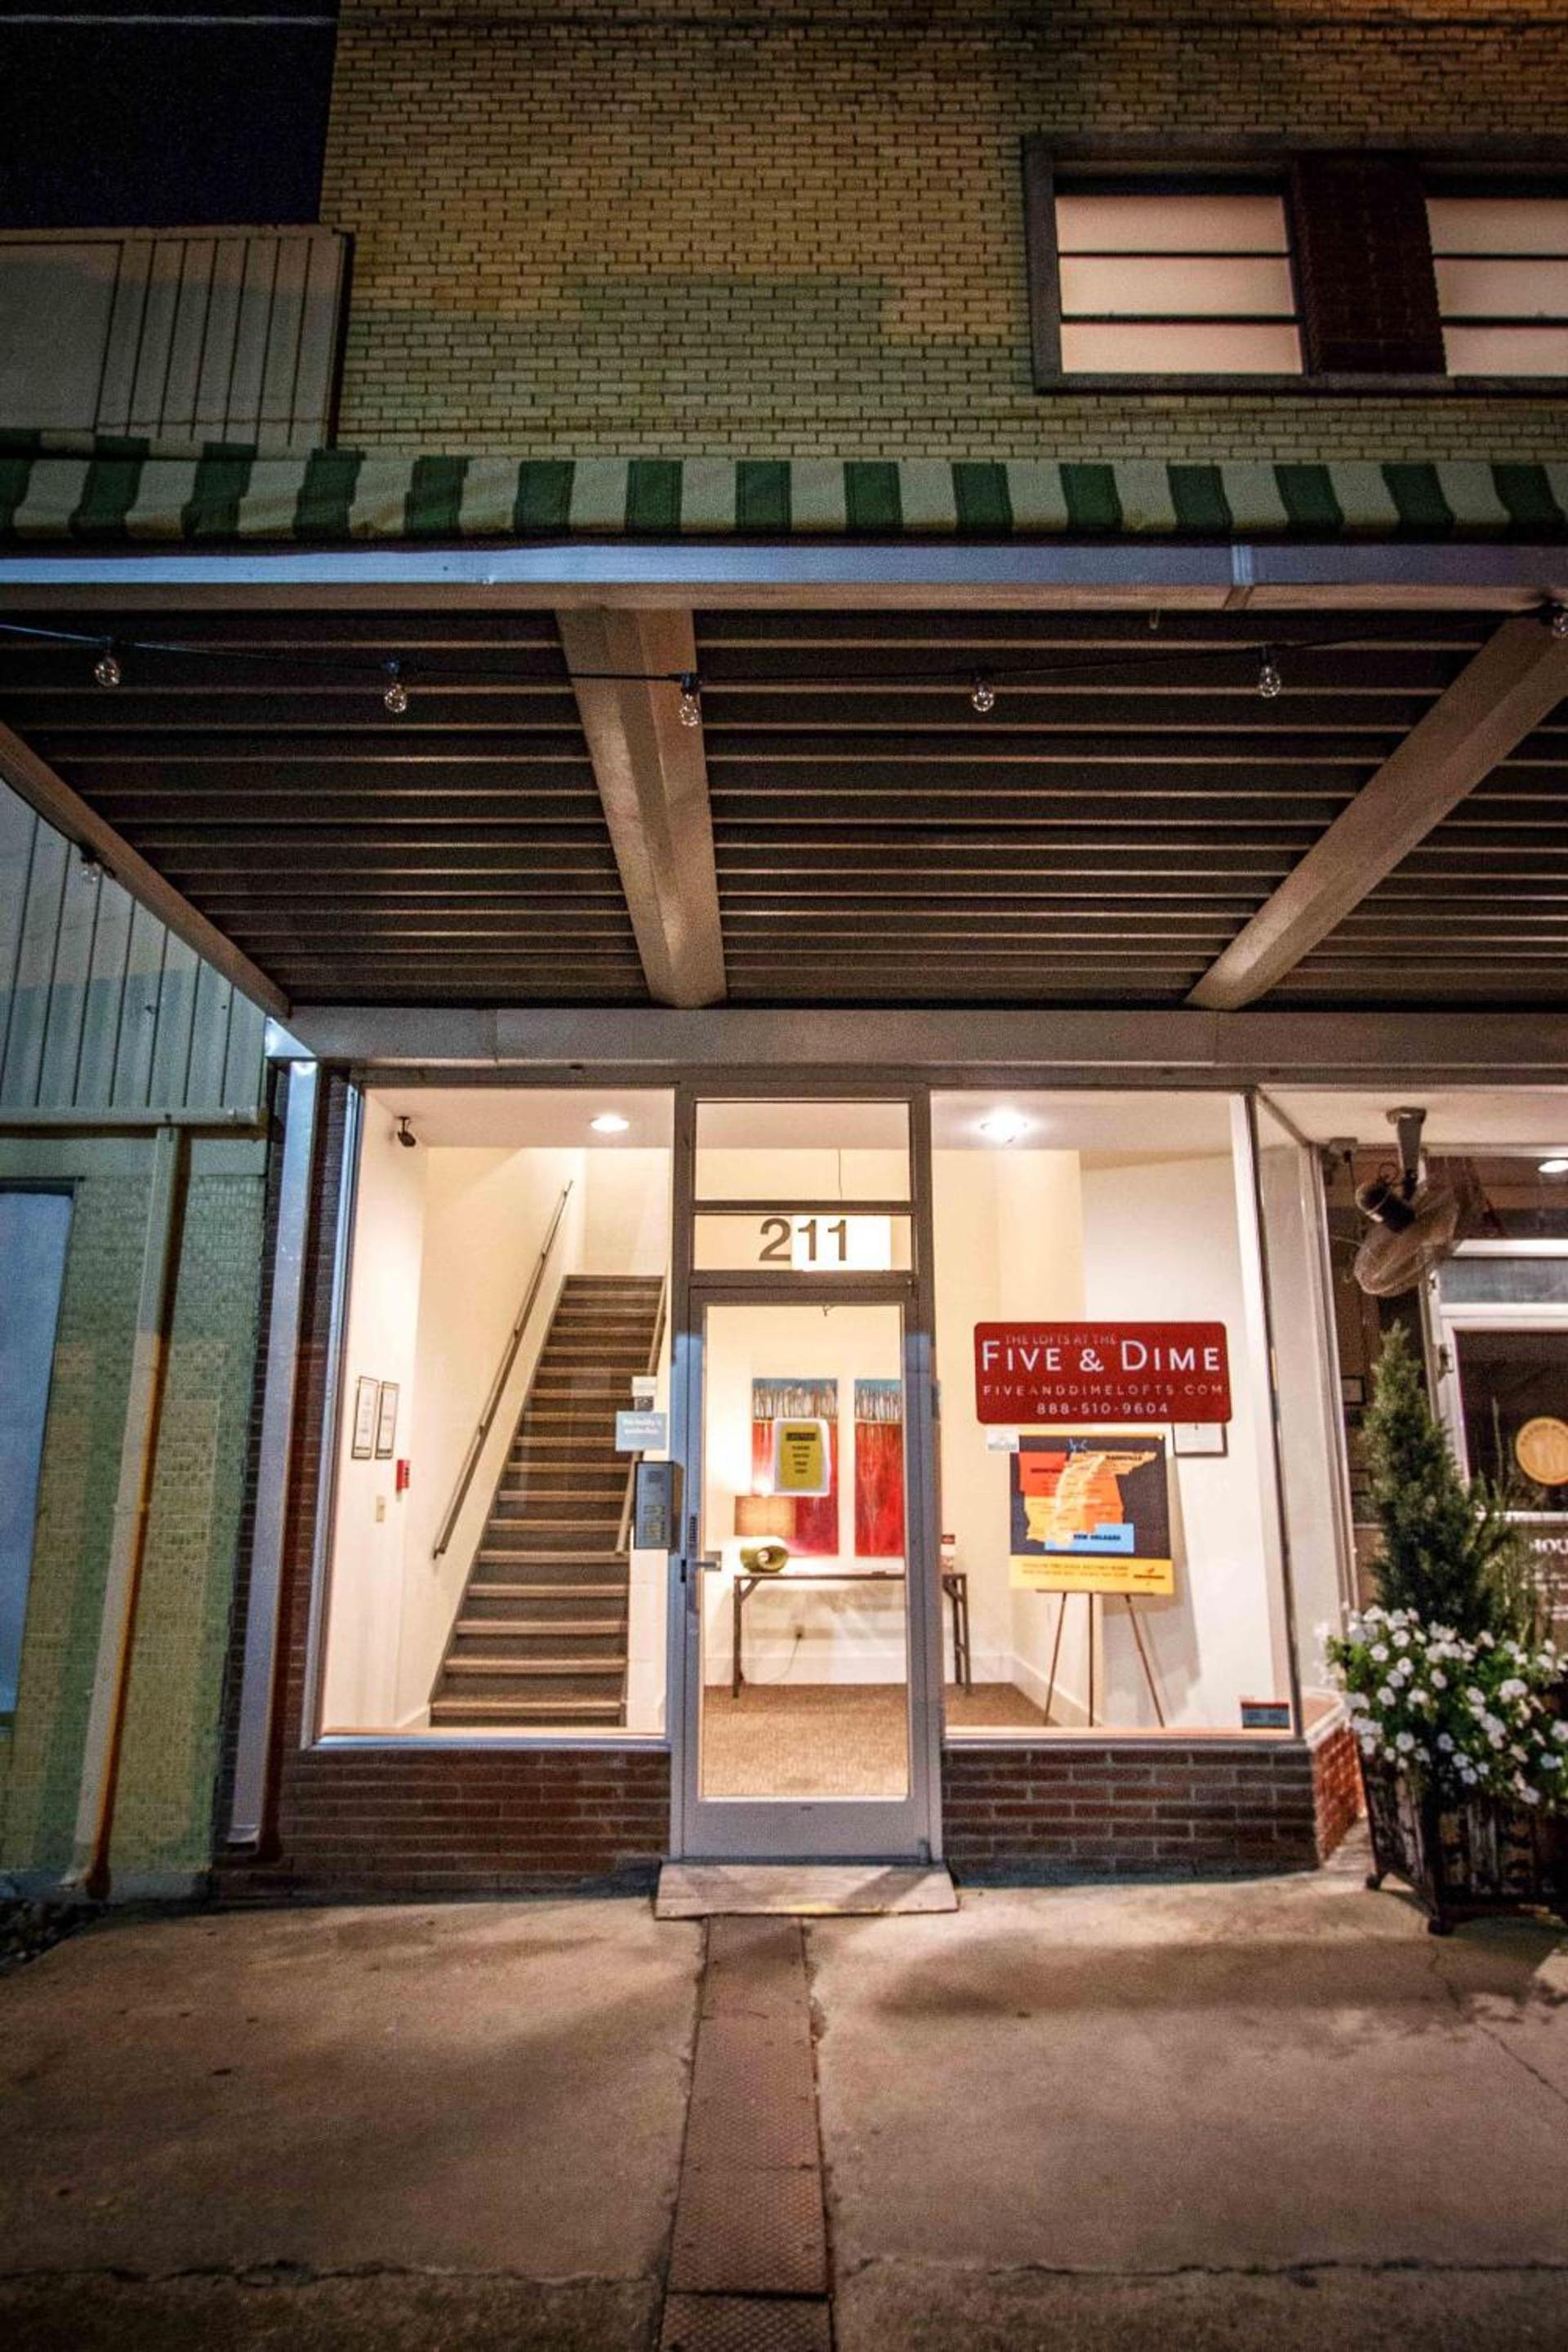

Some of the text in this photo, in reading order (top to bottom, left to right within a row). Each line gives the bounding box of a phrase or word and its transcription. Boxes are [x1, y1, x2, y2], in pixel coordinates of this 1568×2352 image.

[759, 1218, 847, 1262] 211
[1004, 1334, 1117, 1345] THE LOFTS AT THE
[1079, 1348, 1105, 1372] &
[1036, 1402, 1169, 1415] 888-510-9604
